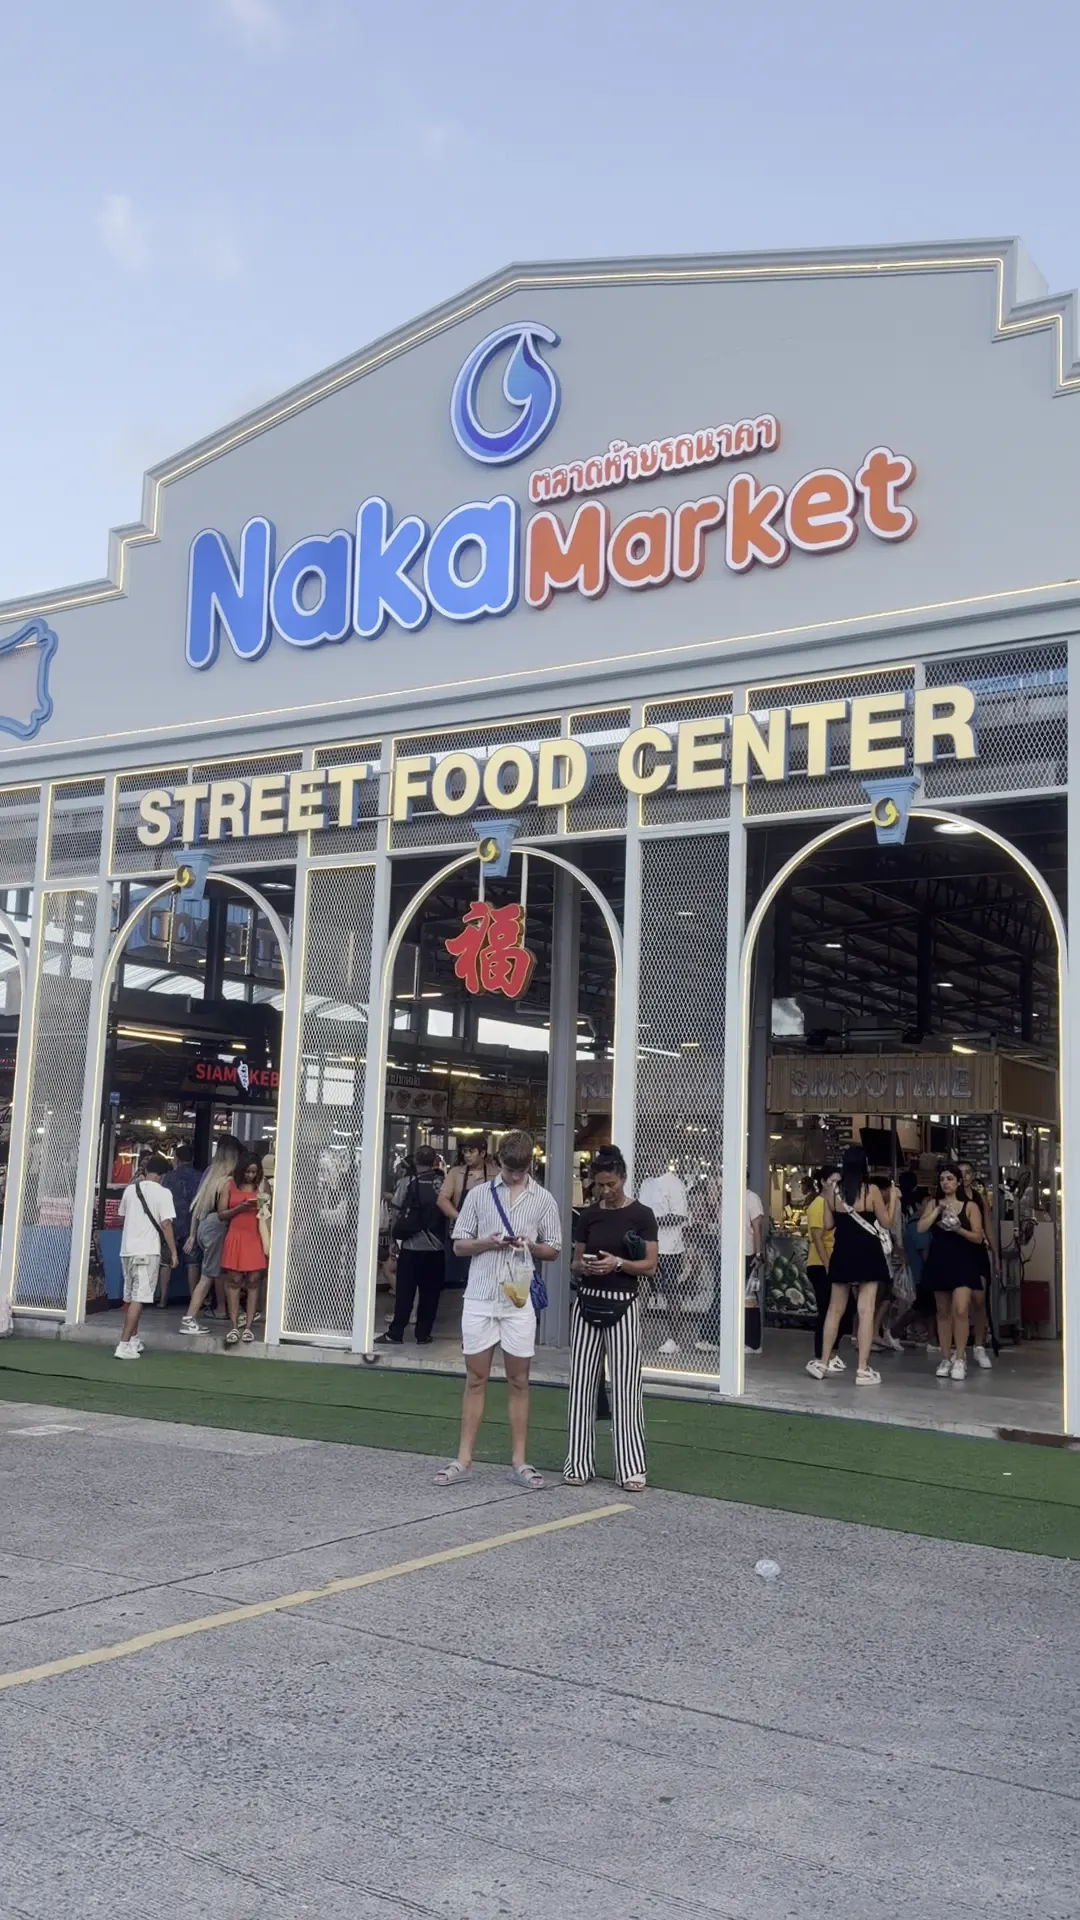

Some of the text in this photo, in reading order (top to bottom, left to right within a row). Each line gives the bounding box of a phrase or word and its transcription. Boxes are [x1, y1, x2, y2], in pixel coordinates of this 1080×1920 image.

[529, 413, 781, 505] ตลาดท้ายรถนาคา
[184, 446, 917, 670] Naka Market
[136, 686, 979, 846] STREET FOOD CENTER
[445, 901, 537, 998] 福
[195, 1063, 237, 1082] SIAM
[791, 1067, 972, 1098] SMOOTHIE
